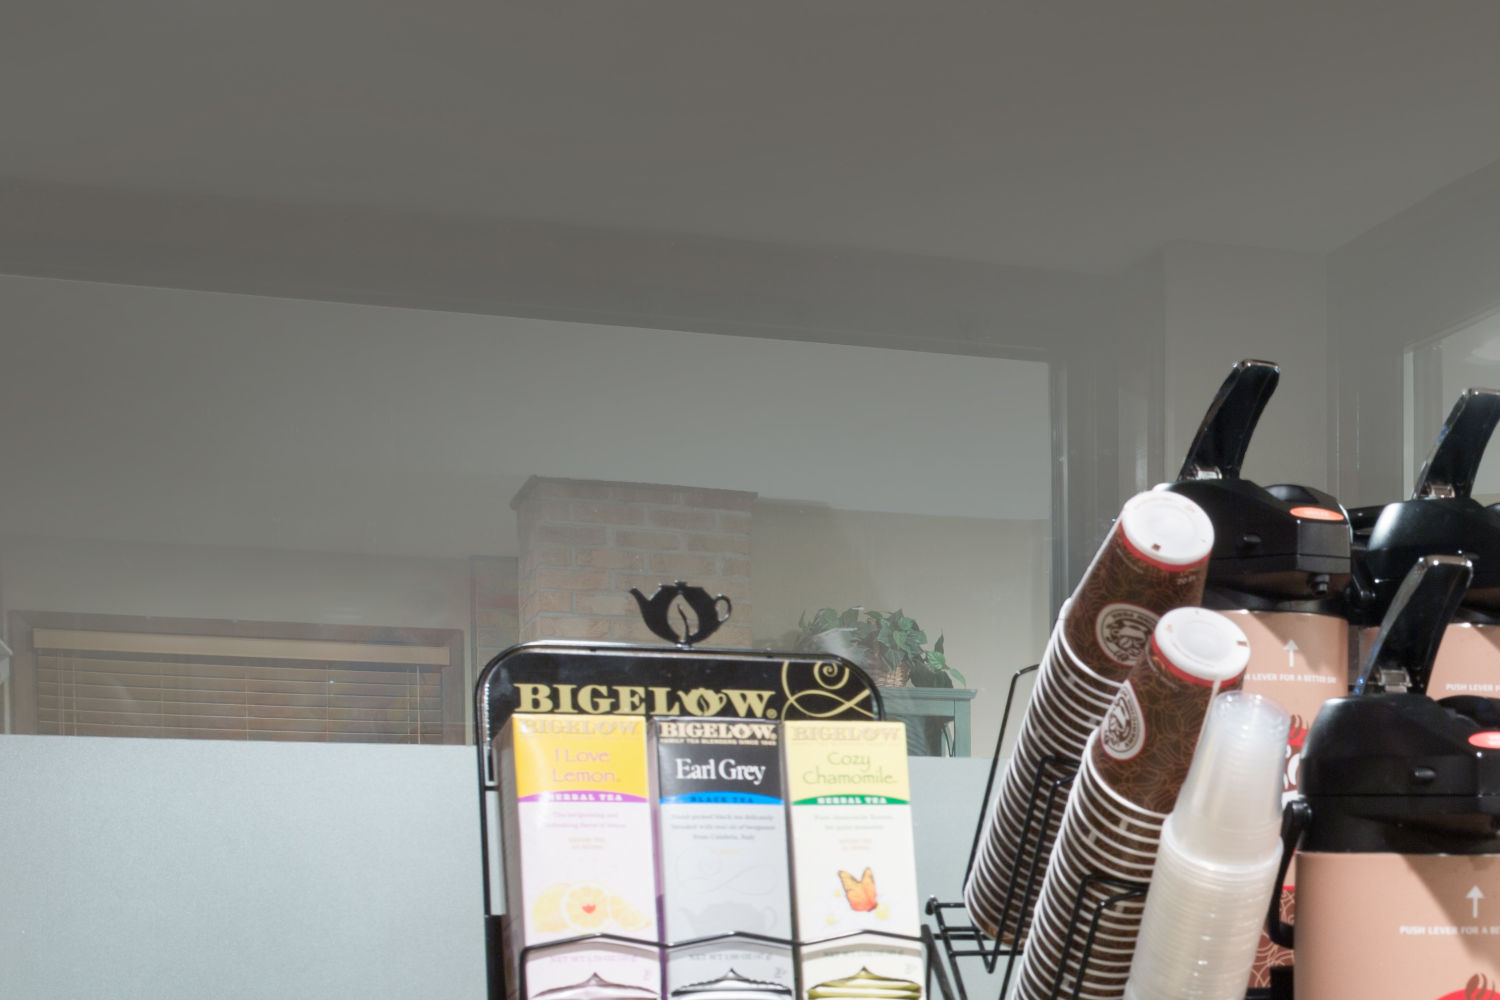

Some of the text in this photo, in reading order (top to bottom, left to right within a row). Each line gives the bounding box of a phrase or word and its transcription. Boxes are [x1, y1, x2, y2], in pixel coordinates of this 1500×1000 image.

[513, 683, 777, 719] BIGELOW
[519, 719, 640, 735] BIGELOW
[660, 722, 777, 739] BIGELOW
[792, 726, 901, 742] BIGELOW
[565, 748, 611, 763] Love
[827, 752, 871, 773] Cozy
[552, 769, 617, 783] Lemon
[675, 758, 766, 785] Earl Grey
[802, 765, 895, 785] Chamomile
[598, 793, 624, 801] TEA
[816, 797, 888, 805] HERBAL TEA
[1400, 926, 1426, 935] PUSH
[1427, 926, 1458, 935] LEVER
[1461, 925, 1479, 934] FOR
[1481, 926, 1489, 934] A
